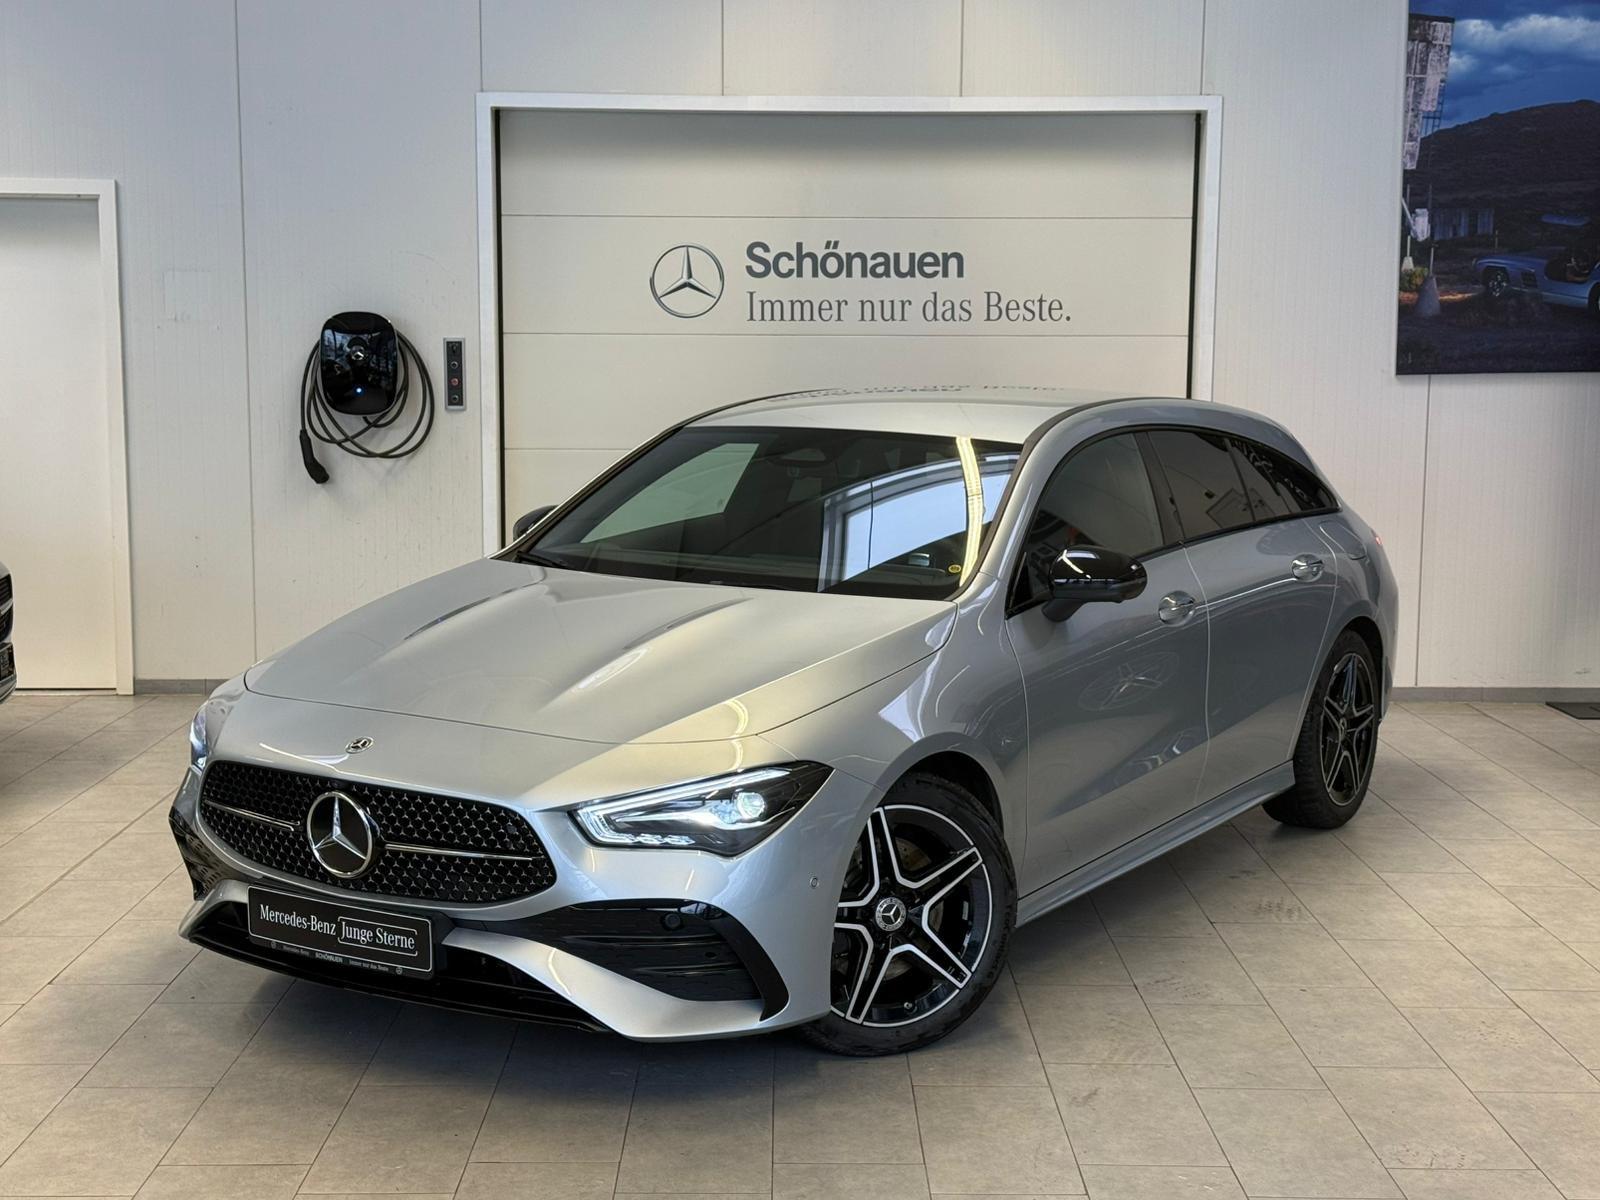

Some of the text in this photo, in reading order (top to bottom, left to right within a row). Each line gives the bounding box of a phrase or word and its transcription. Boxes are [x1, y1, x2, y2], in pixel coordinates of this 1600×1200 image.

[745, 240, 964, 279] Schönauen
[746, 291, 1071, 323] Immer nur das Beste.
[260, 904, 415, 949] Mercedes-Benz Junge Sterne
